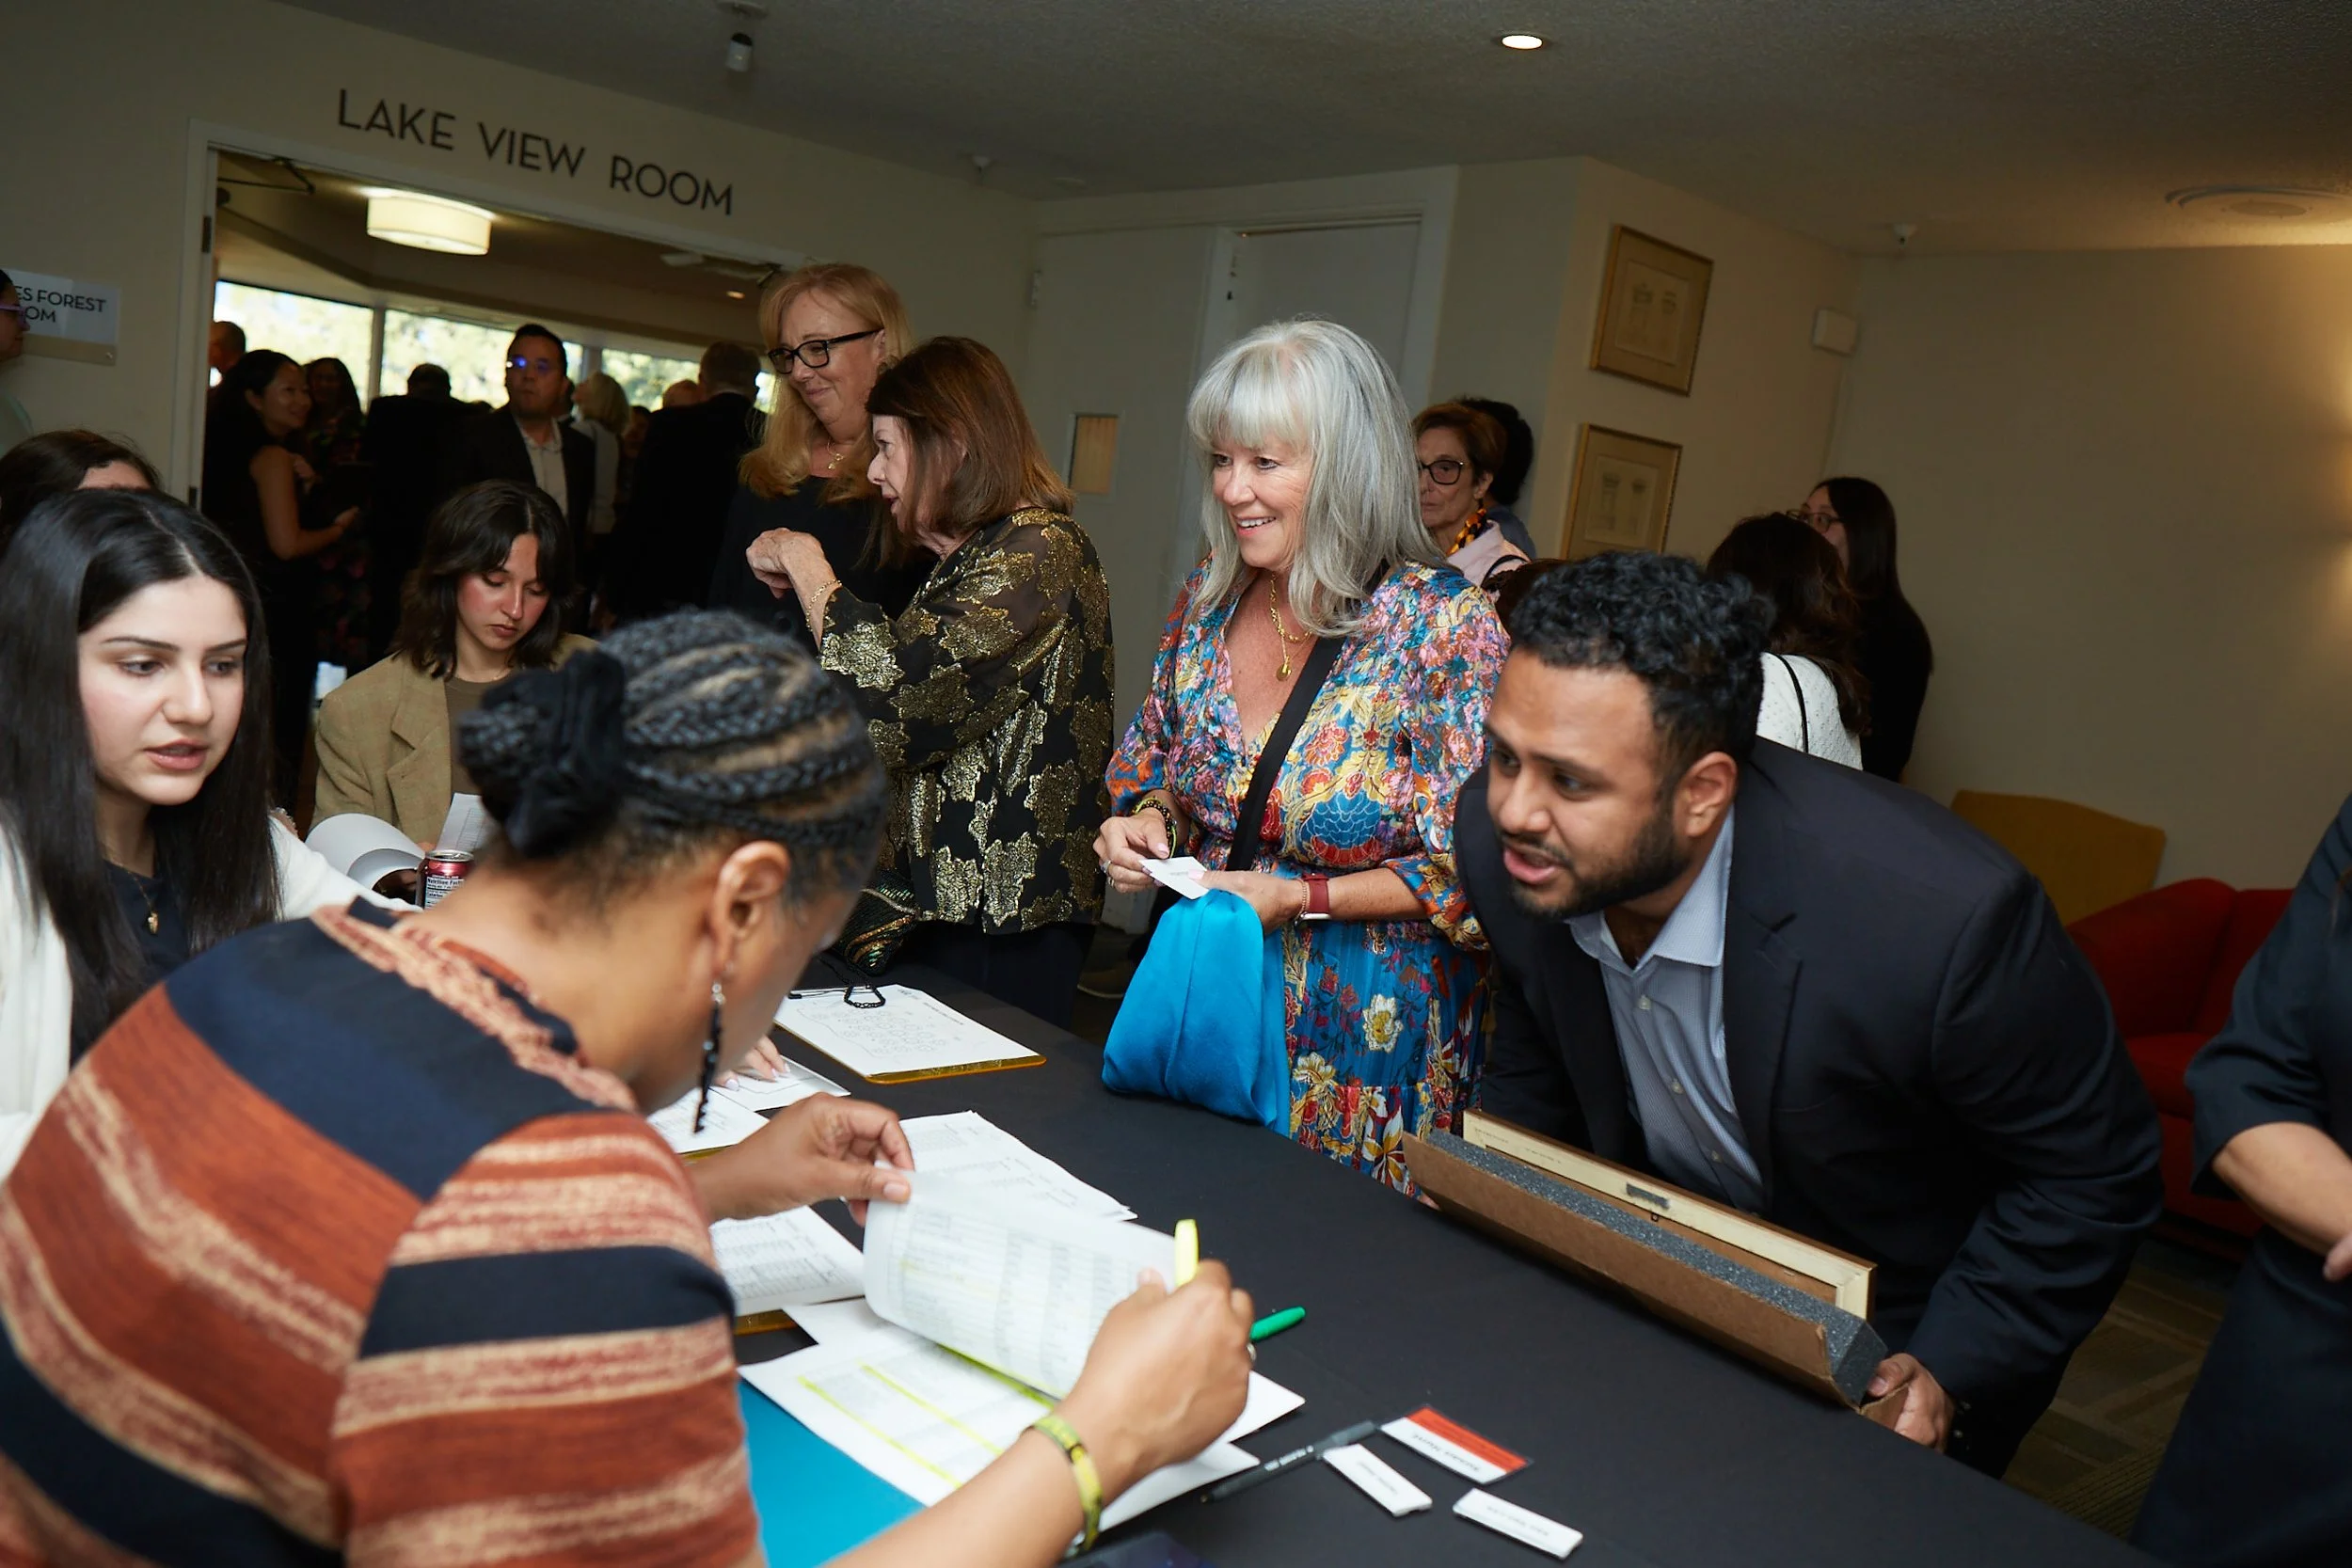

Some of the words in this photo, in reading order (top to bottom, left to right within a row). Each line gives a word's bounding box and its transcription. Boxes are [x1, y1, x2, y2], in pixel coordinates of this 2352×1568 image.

[338, 89, 456, 150] LAKE
[477, 121, 586, 177] VIEW
[610, 155, 733, 215] ROOM
[14, 285, 33, 301] ES
[38, 290, 106, 312] FOREST
[24, 306, 56, 323] OM
